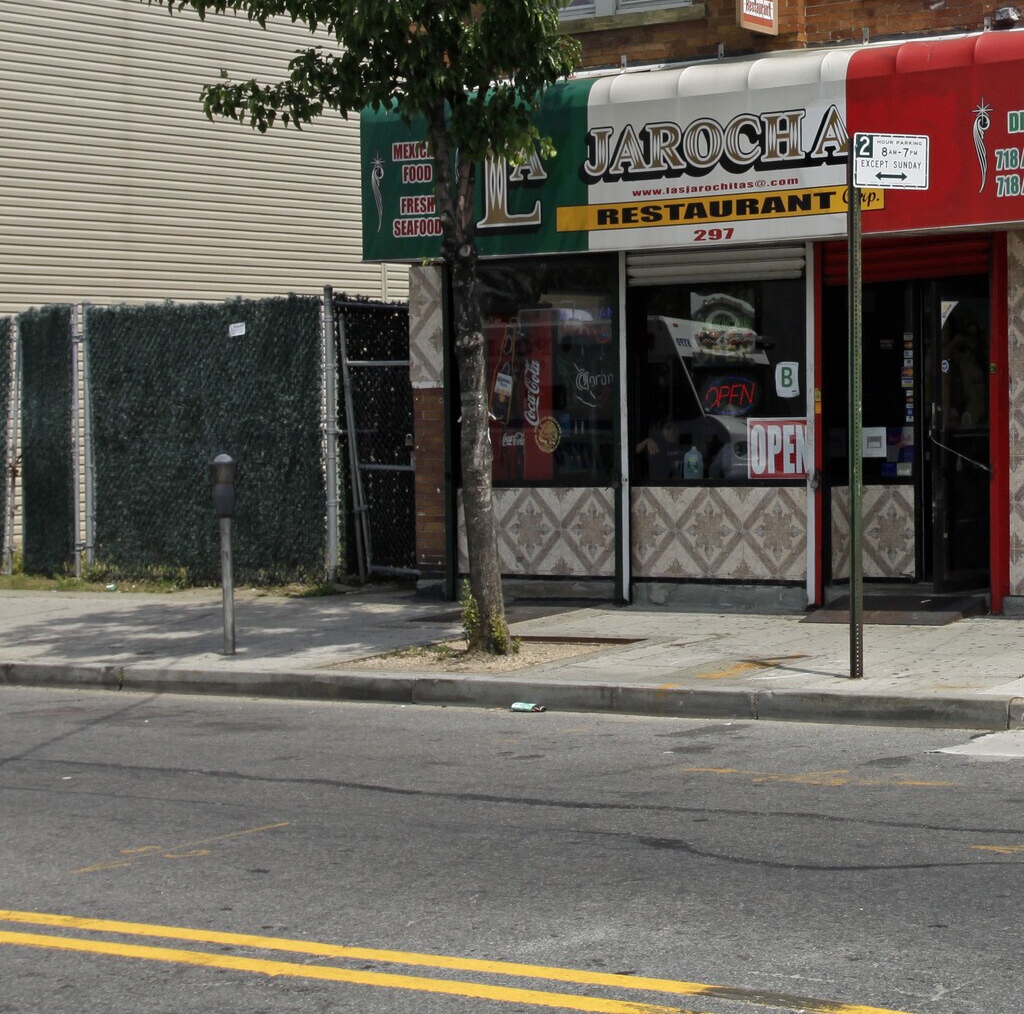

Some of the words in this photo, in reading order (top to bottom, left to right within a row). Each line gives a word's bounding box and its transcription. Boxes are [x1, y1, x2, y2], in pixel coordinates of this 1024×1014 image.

[581, 104, 848, 184] JAROCHA
[860, 136, 870, 155] 2
[861, 160, 888, 168] EXCEPT
[894, 161, 922, 169] SUNDAY
[403, 166, 432, 183] FOOD
[401, 197, 435, 215] FRESH
[597, 191, 837, 225] RESTAURANT
[393, 220, 441, 236] SEAFOOD
[693, 228, 734, 242] 297
[781, 367, 793, 387] B
[705, 383, 756, 407] OPEN
[751, 424, 808, 475] OPEN
